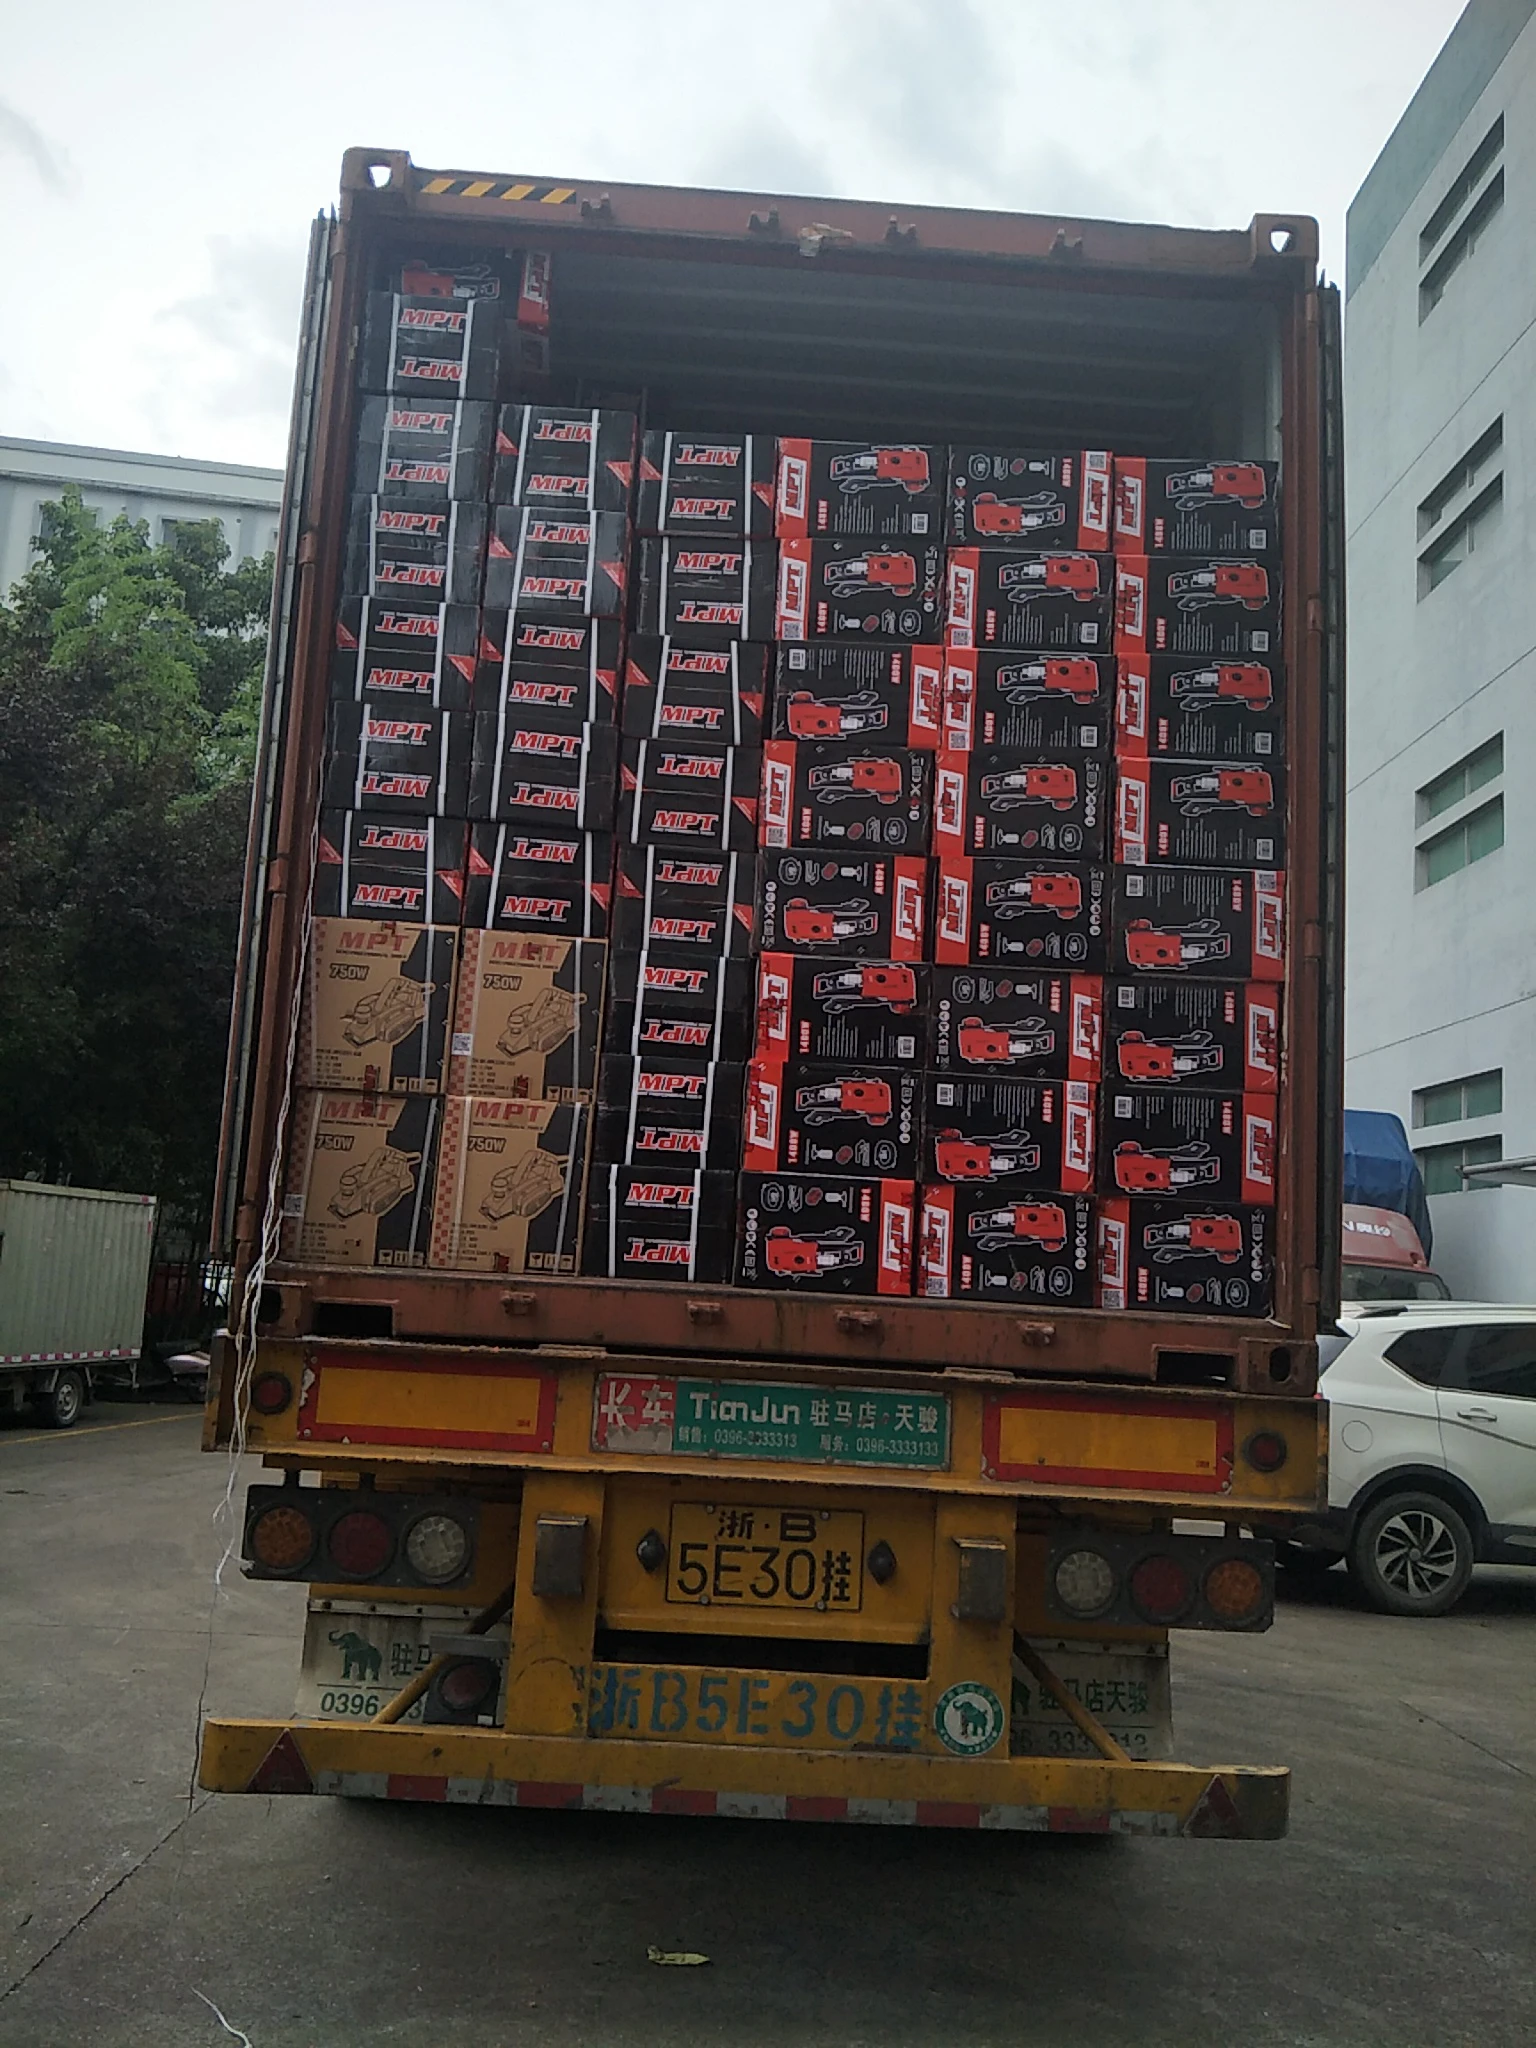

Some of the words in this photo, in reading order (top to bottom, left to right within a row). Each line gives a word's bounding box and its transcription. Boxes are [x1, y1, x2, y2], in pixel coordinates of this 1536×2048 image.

[402, 308, 465, 328] MPT
[398, 360, 462, 381] MPT
[390, 411, 453, 430] MPT
[534, 424, 592, 441] MPT
[676, 450, 736, 466] MPT
[385, 465, 449, 483] MPT
[531, 475, 591, 493] MPT
[784, 461, 800, 511] MPT
[674, 498, 734, 516] MPT
[1089, 478, 1104, 526] MPT
[379, 512, 444, 532] MPT
[528, 526, 590, 544] MPT
[677, 552, 742, 571] MPT
[378, 566, 441, 586] MPT
[524, 577, 586, 596] MPT
[784, 562, 800, 612] MPT
[952, 570, 968, 620] MPT
[676, 605, 742, 624] MPT
[377, 616, 439, 636] MPT
[517, 628, 583, 650] MPT
[664, 653, 728, 674] MPT
[369, 669, 436, 689] MPT
[511, 682, 579, 703] MPT
[950, 672, 967, 721] MT
[660, 705, 725, 725] MPT
[367, 721, 431, 741] MPT
[513, 731, 583, 754] MPT
[655, 757, 722, 778] MPT
[360, 775, 428, 798] MPT
[768, 766, 784, 818] MPT
[507, 786, 578, 810] MPT
[1123, 783, 1139, 832] MPT
[654, 811, 721, 832] MPT
[360, 829, 428, 851] MPT
[507, 841, 576, 863] MPT
[653, 863, 720, 886] MPT
[355, 885, 426, 905] MPT
[503, 896, 573, 918] MPT
[945, 882, 961, 935] MPT
[650, 918, 719, 939] MPT
[1262, 900, 1277, 953] MPT
[338, 931, 410, 952] MPT
[329, 963, 369, 980] 750W
[643, 966, 710, 989] MPT
[483, 974, 521, 991] 750W
[766, 978, 781, 1030] MT
[638, 1022, 710, 1046] MPT
[638, 1072, 709, 1095] MPT
[475, 1101, 546, 1122] MPT
[315, 1134, 354, 1151] 750W
[468, 1136, 506, 1153] 750W
[634, 1130, 706, 1153] MPT
[1072, 1111, 1088, 1166] MPT
[628, 1183, 700, 1205] MPT
[621, 1241, 693, 1264] MPT
[1102, 1224, 1119, 1278] MPT
[690, 1392, 800, 1425] TianJun
[677, 1543, 851, 1601] 5E30挂
